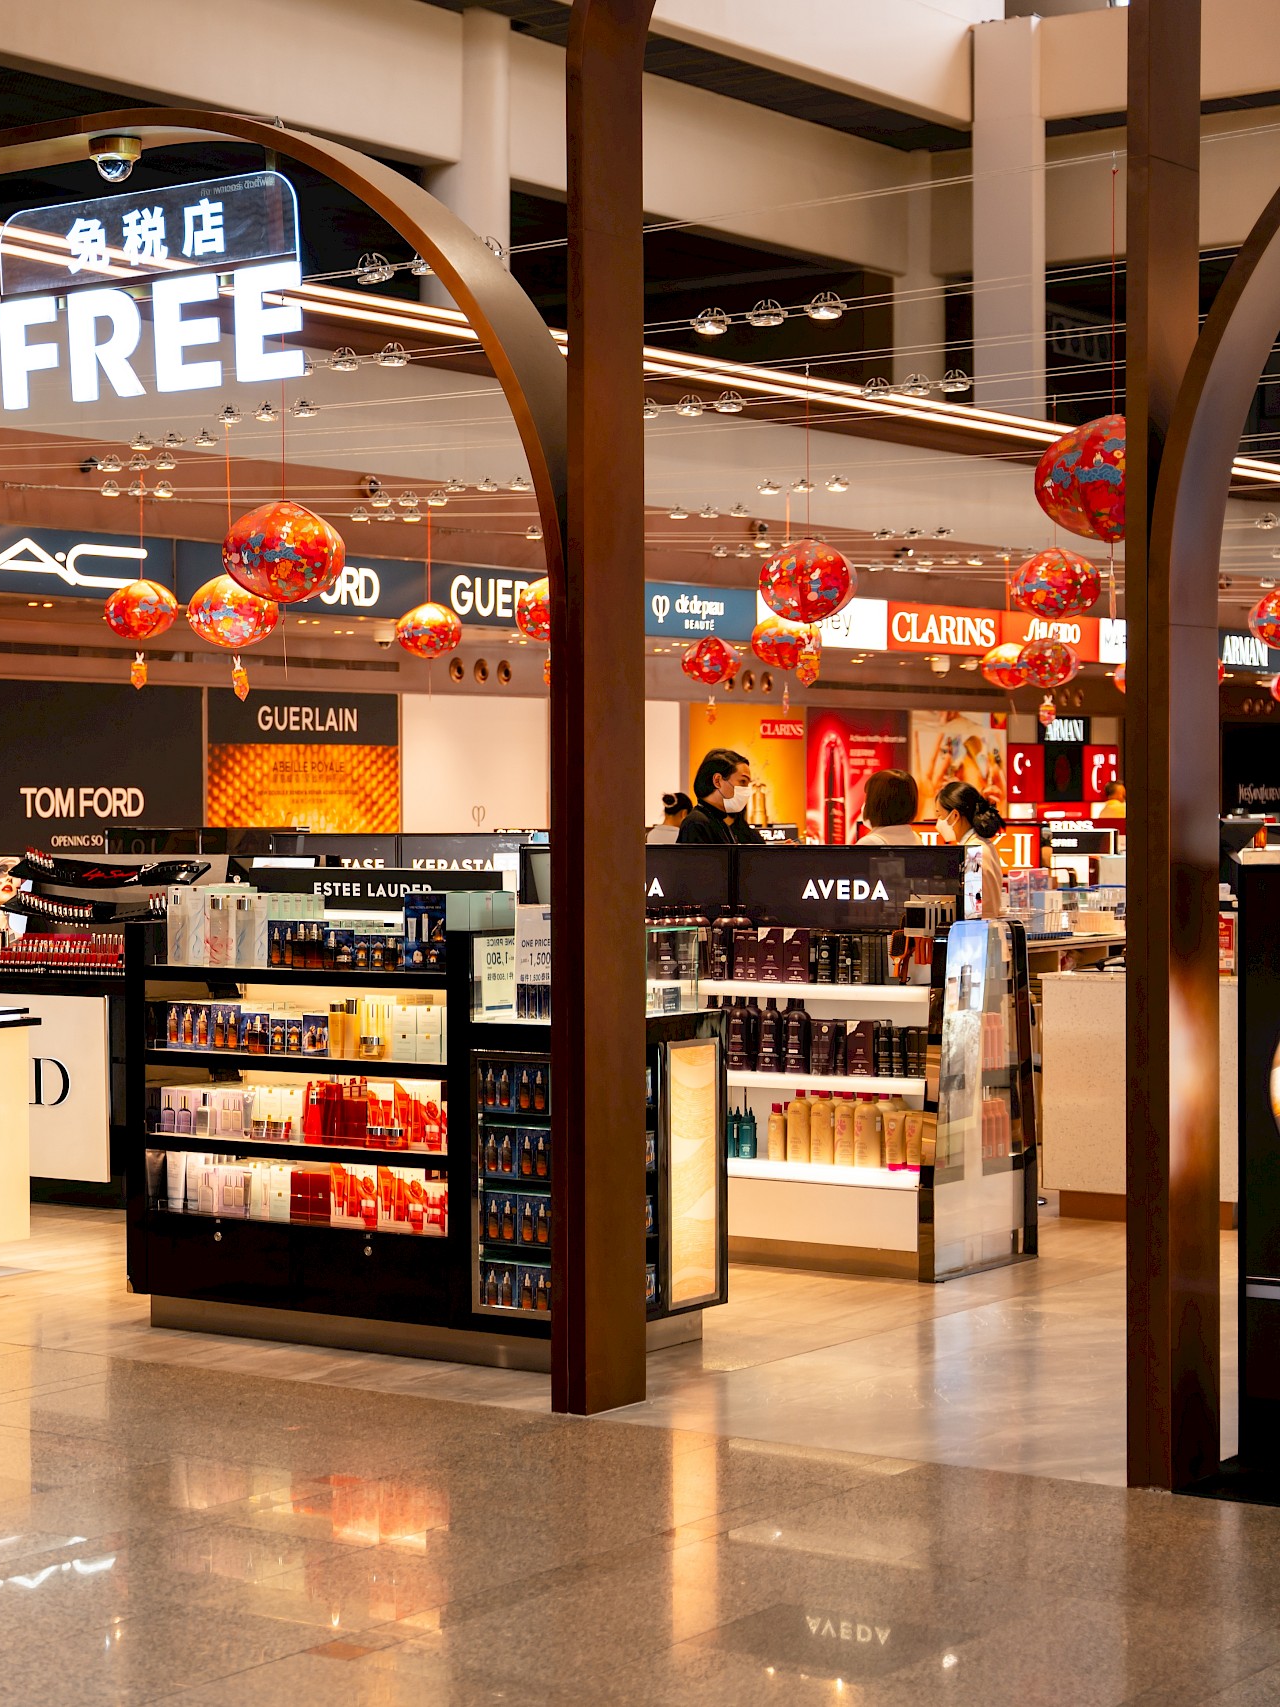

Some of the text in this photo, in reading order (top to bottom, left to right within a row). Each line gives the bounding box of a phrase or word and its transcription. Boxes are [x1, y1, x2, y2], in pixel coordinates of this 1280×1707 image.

[66, 199, 225, 274] 免税店
[304, 566, 380, 607] ORD
[891, 611, 996, 648] CLARINS
[1222, 635, 1269, 667] ARMANI
[258, 705, 358, 732] GUERLAIN
[760, 723, 804, 736] CLARINS
[20, 788, 145, 818] TOM FORD
[51, 835, 91, 847] OPENING
[313, 882, 361, 897] ESTEE
[802, 879, 889, 901] AVEDA
[521, 938, 551, 948] ONE PRICE
[530, 952, 551, 967] 1,500
